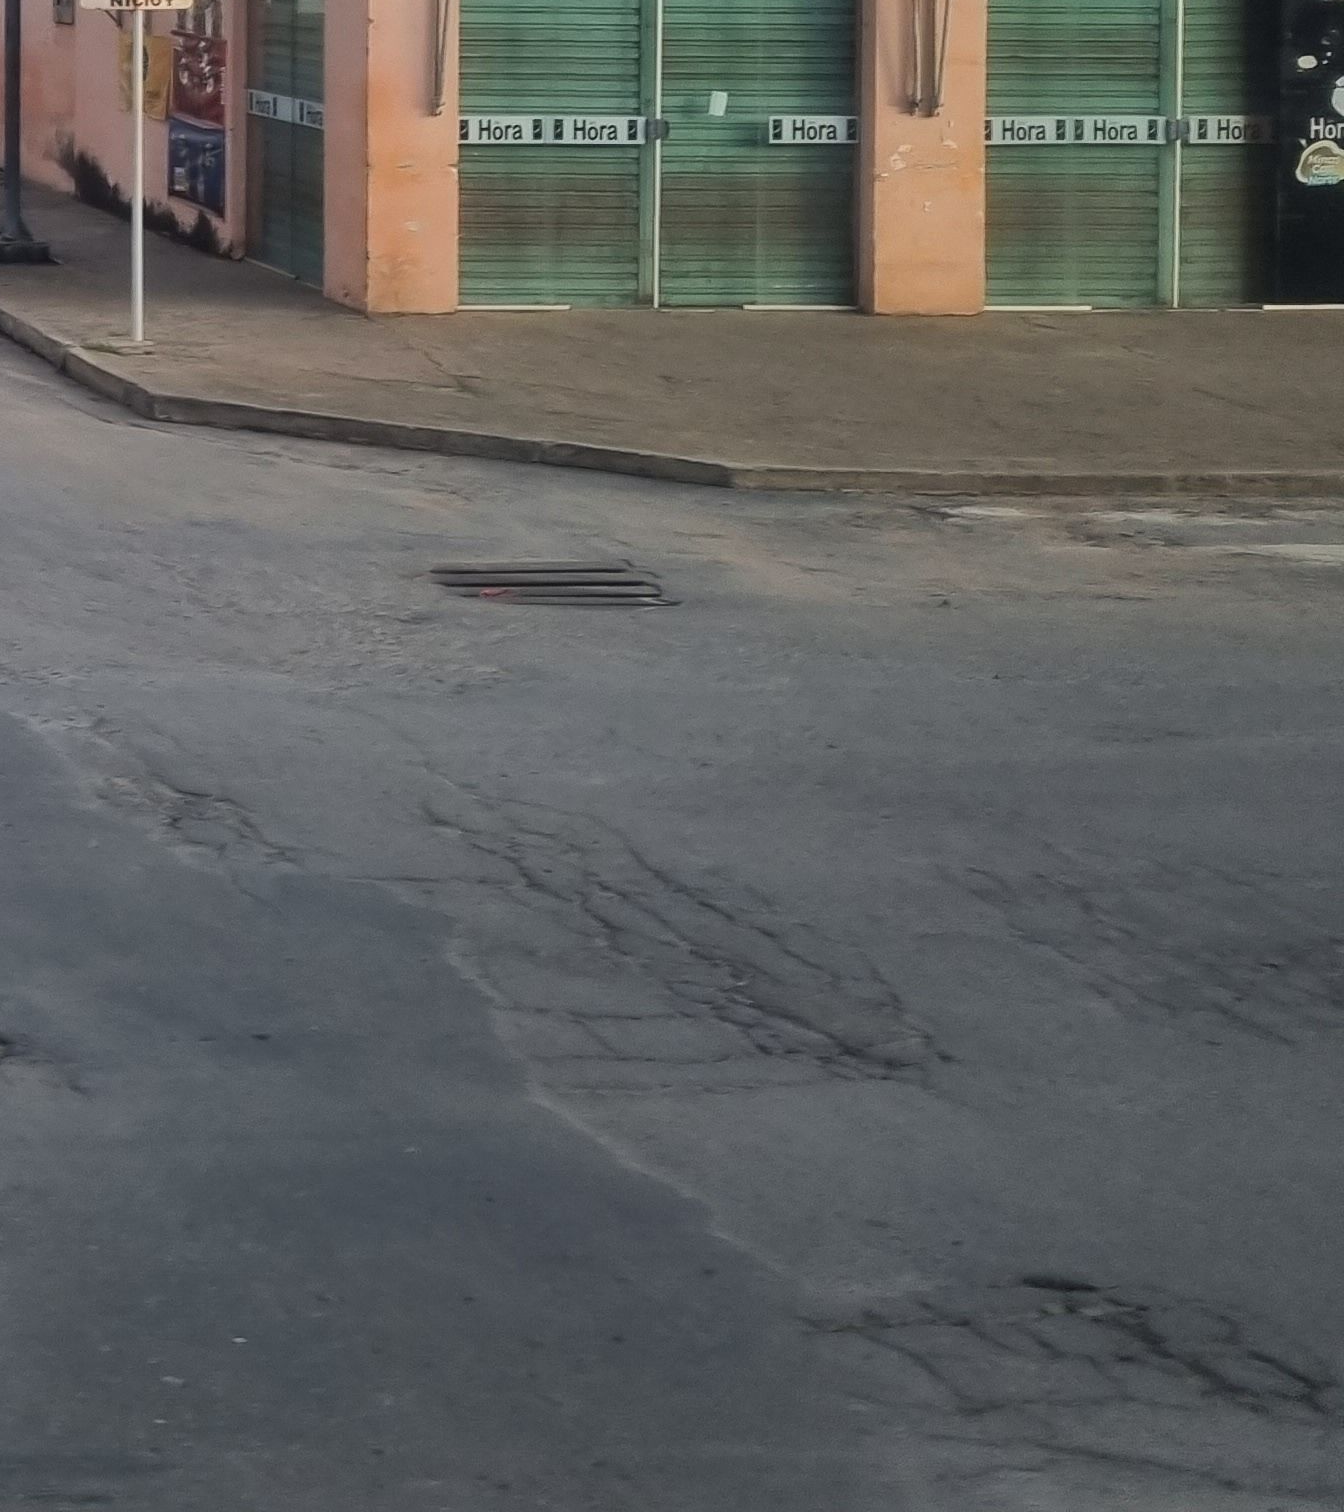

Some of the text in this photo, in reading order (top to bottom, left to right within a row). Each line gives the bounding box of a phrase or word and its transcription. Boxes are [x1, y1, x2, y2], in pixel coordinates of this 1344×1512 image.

[478, 119, 523, 140] Hora
[573, 119, 617, 140] Hora
[792, 119, 837, 140] Hora
[1002, 119, 1046, 141] Hora
[1093, 119, 1138, 141] Hora
